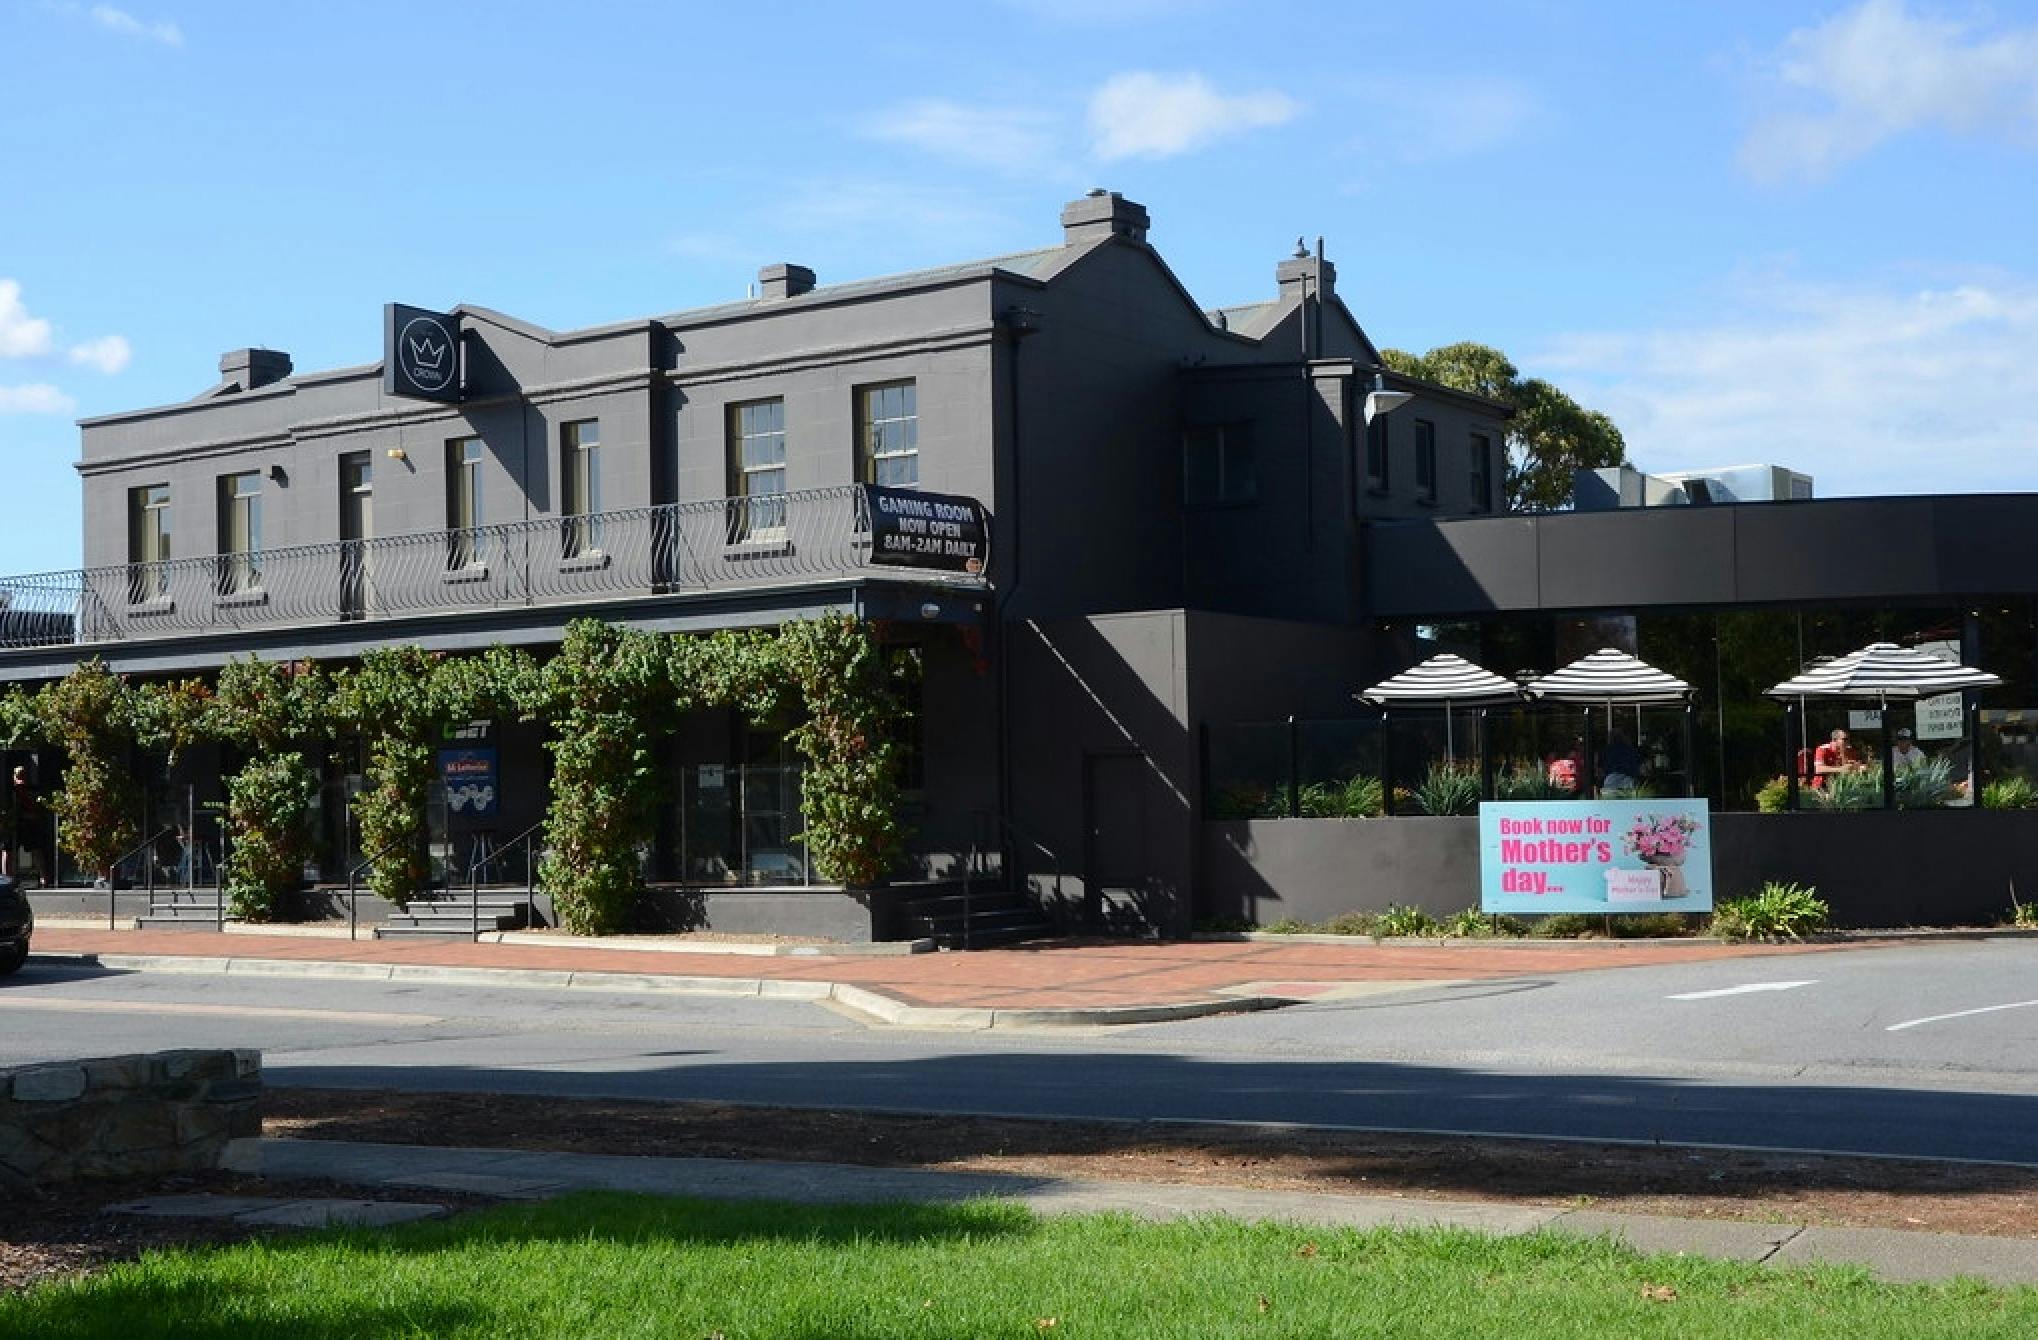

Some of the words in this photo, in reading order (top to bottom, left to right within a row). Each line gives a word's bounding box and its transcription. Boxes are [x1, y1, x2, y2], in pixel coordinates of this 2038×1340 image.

[879, 496, 933, 517] GAMING
[934, 503, 974, 522] ROOM
[899, 518, 927, 534] NOW
[929, 521, 961, 538] OPEN
[945, 540, 977, 557] DAILY
[1500, 817, 1542, 835] Book
[1547, 819, 1583, 834] now
[1586, 815, 1611, 834] for
[1501, 838, 1612, 864] Mother's
[1503, 867, 1564, 894] day...
